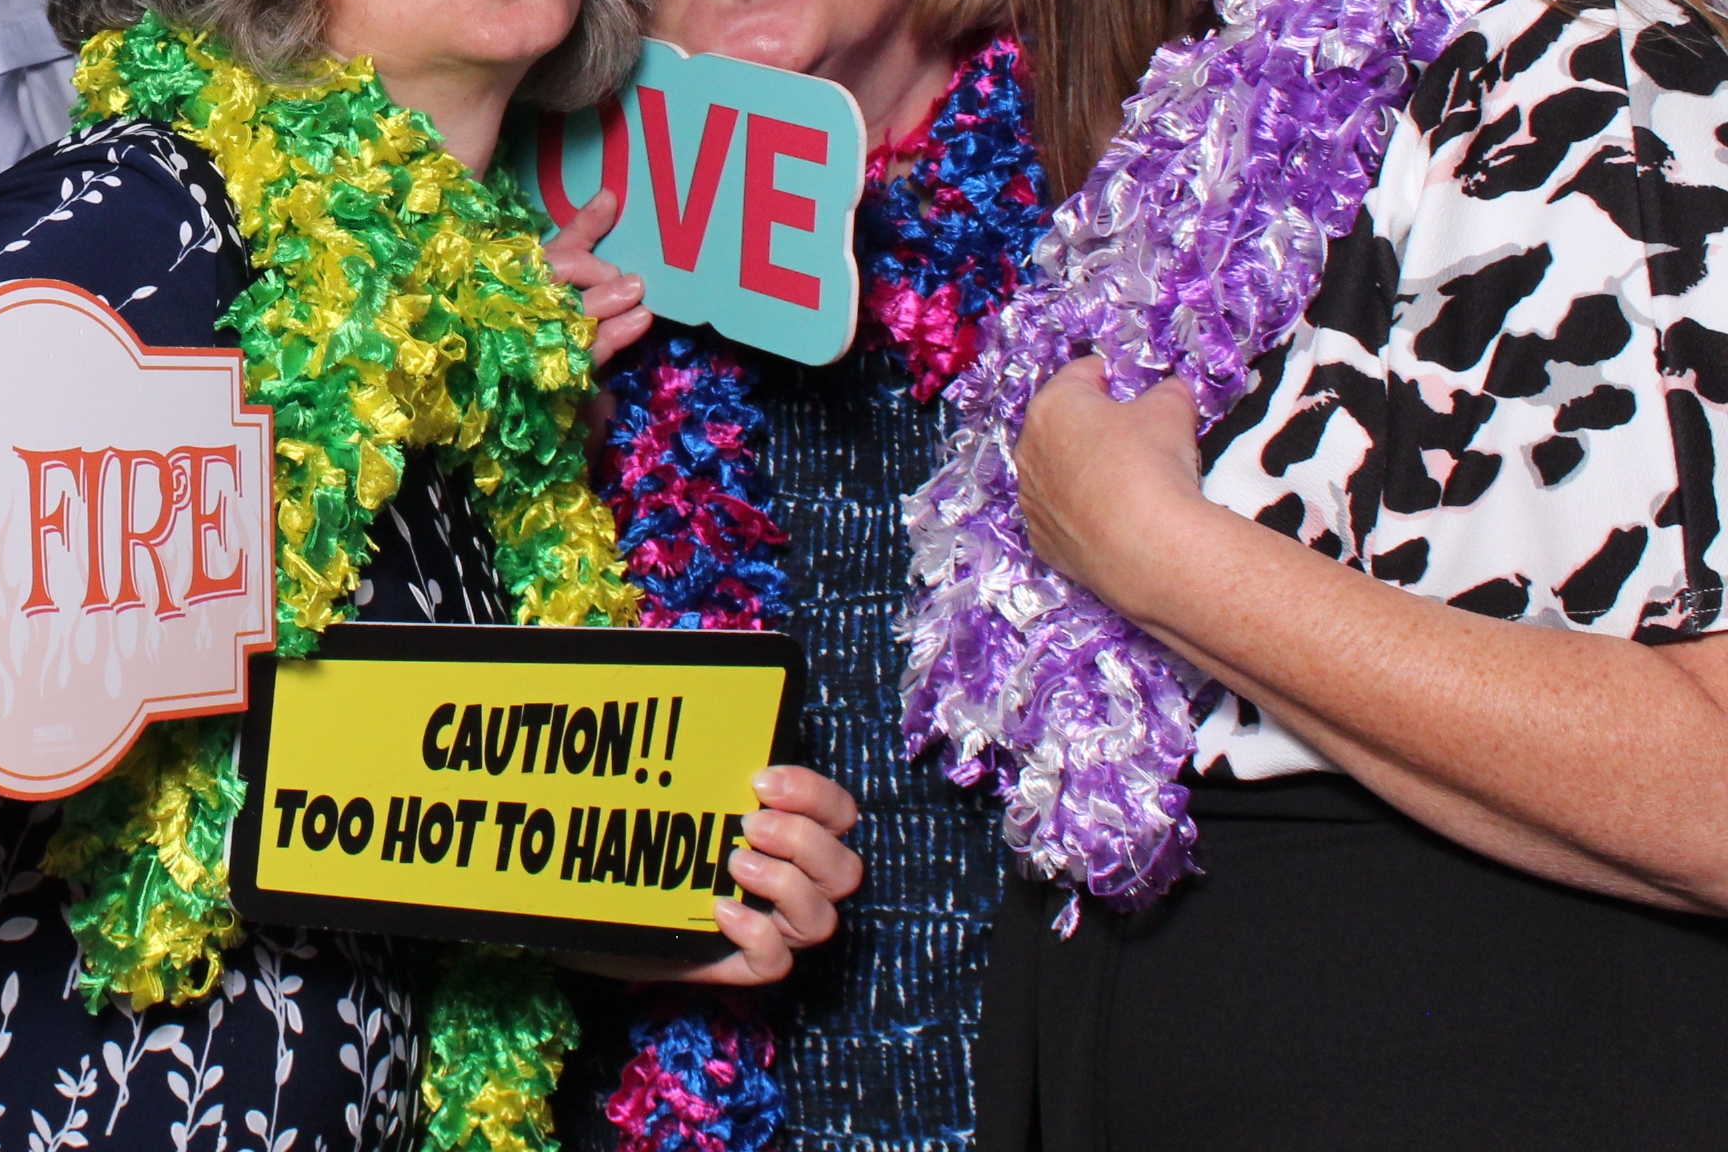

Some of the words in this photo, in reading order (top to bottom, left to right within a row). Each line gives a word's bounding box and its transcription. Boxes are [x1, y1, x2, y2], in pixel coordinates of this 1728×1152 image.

[536, 85, 828, 310] OVE
[12, 444, 248, 623] FIRE
[422, 697, 683, 788] CAUTION!!
[274, 789, 375, 855] TOO
[381, 796, 488, 870] HOT
[495, 801, 556, 875] TO
